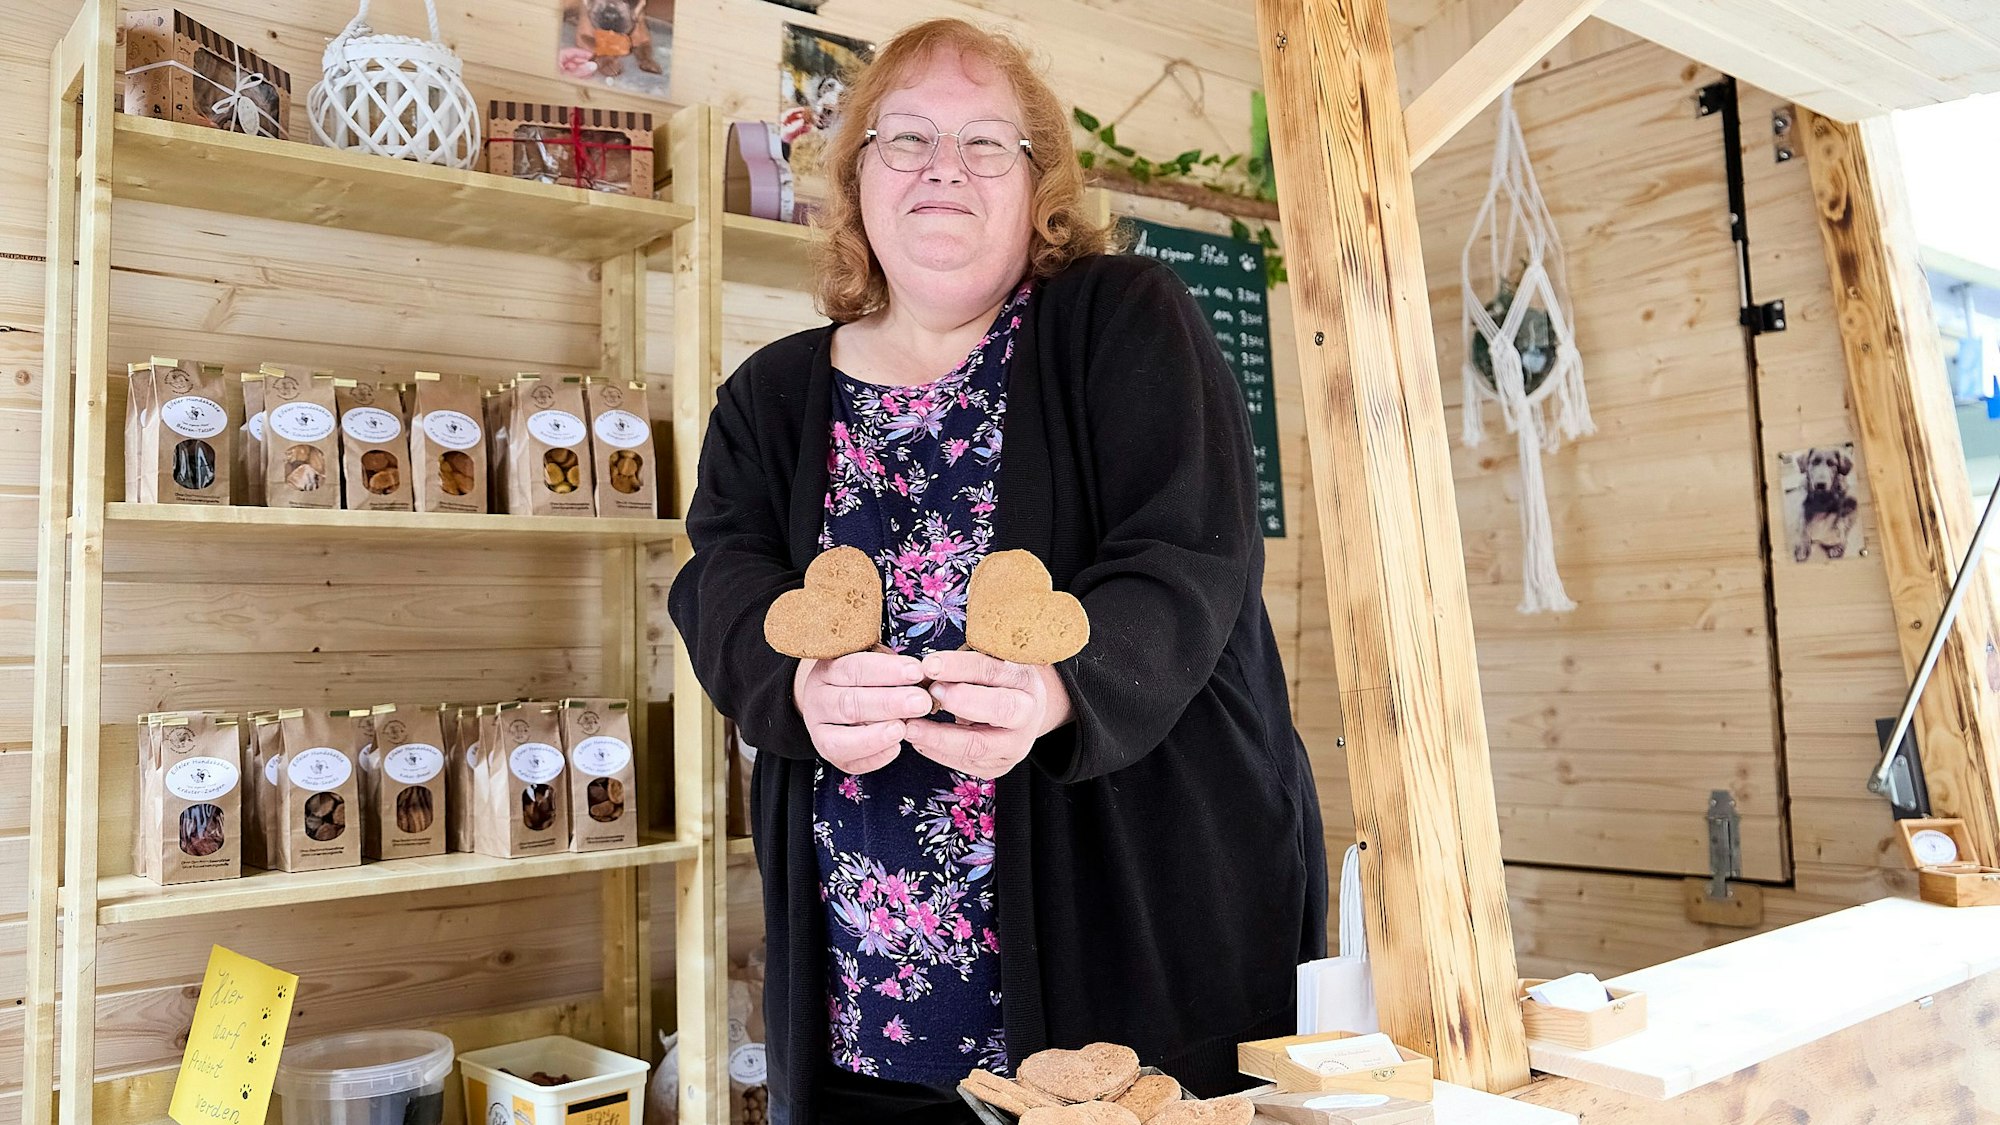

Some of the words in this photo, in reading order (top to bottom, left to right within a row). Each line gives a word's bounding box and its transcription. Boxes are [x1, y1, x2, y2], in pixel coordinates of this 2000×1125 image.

[1159, 246, 1195, 264] eigener
[1199, 243, 1229, 266] Pfote
[209, 968, 244, 1009] Hier
[212, 1014, 248, 1050] darf
